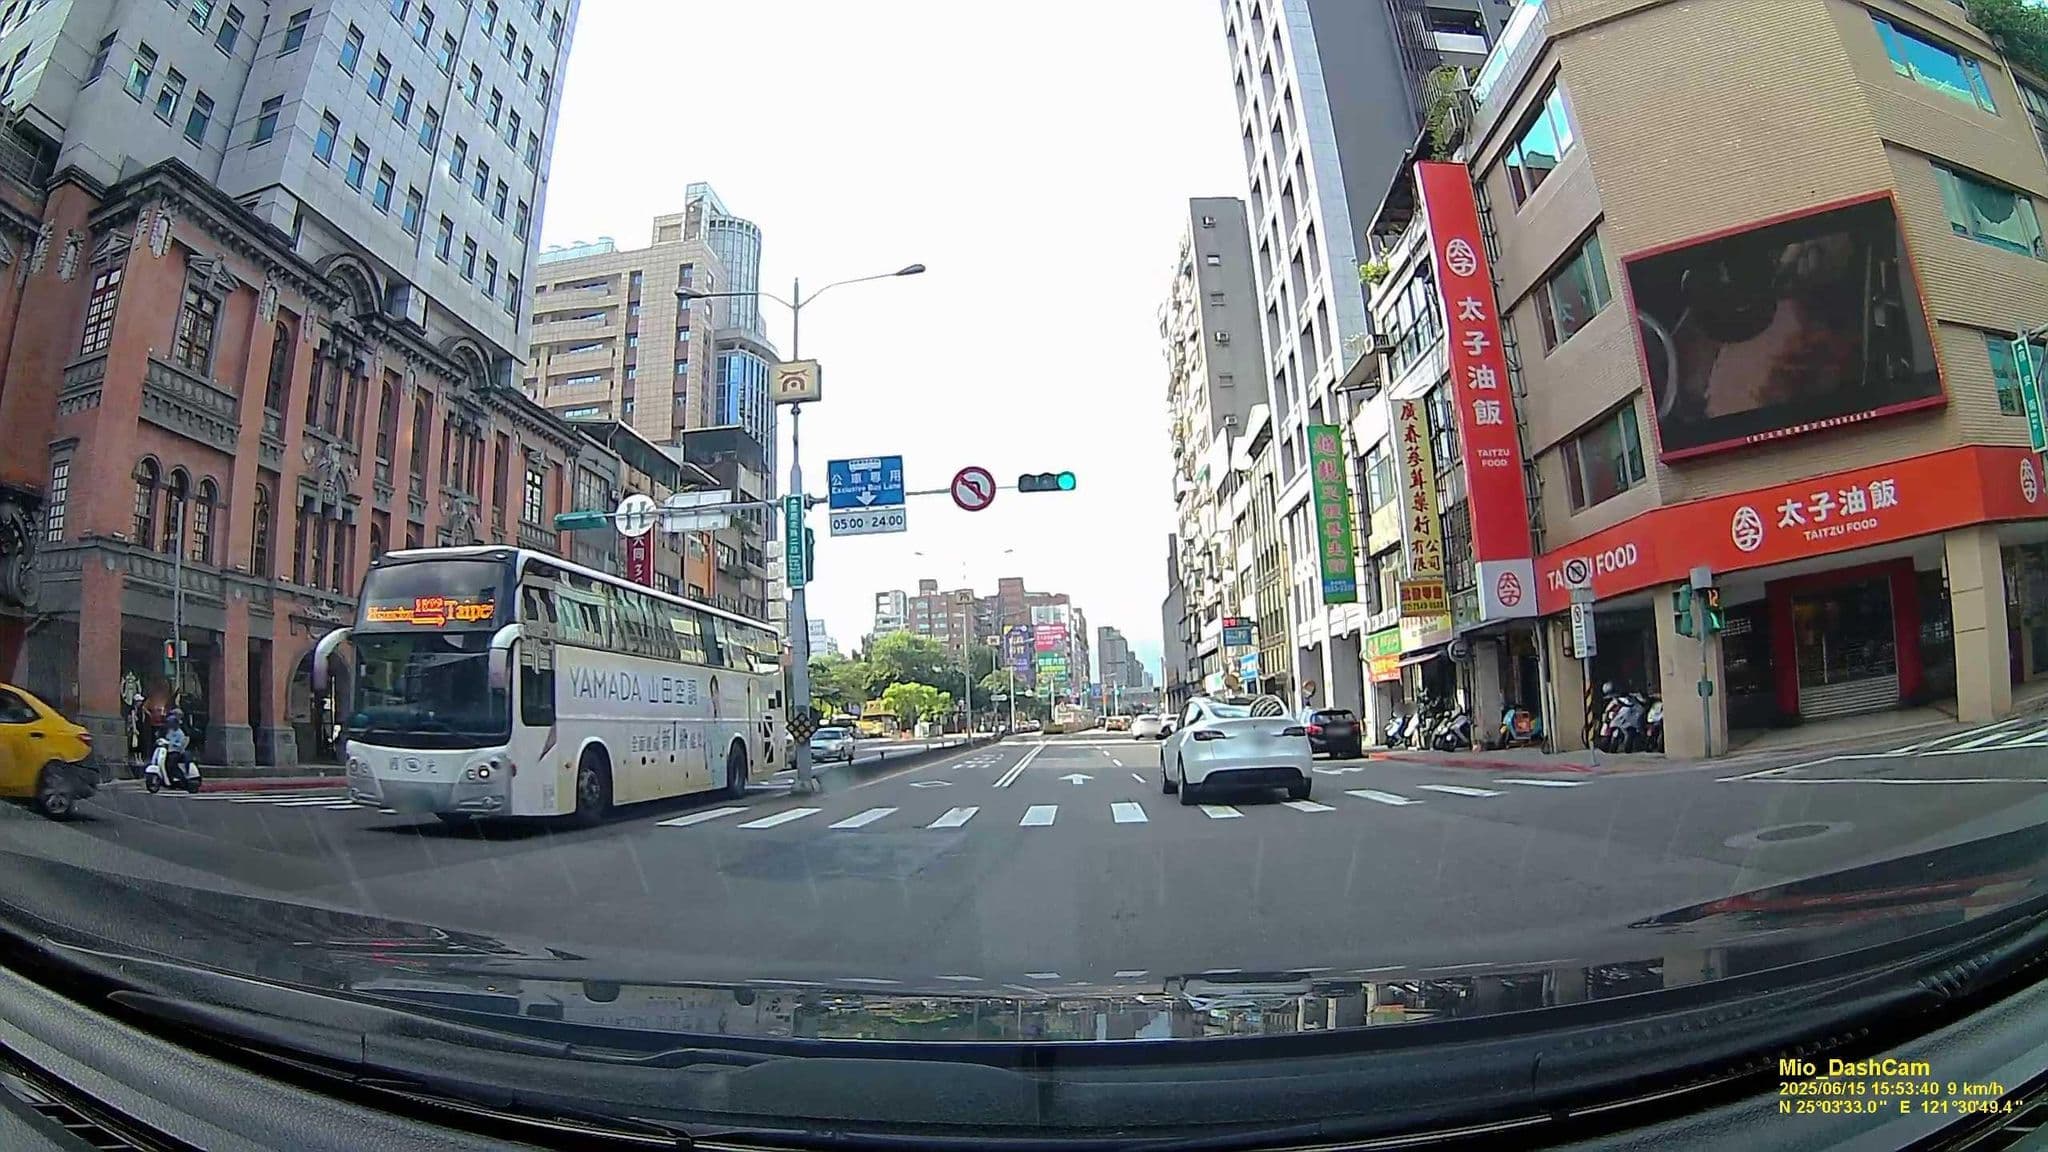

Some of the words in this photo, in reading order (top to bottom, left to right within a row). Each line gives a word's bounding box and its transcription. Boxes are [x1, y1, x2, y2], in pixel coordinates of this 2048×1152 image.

[1457, 296, 1503, 425] 太子油飯
[1478, 448, 1510, 458] TAITZU
[1481, 459, 1508, 468] FOOD
[831, 469, 901, 486] 公車專用
[1776, 478, 1898, 528] 太子油飯
[1803, 525, 1845, 541] TAITZU
[1846, 518, 1878, 532] FOOD
[1596, 543, 1637, 576] FOOD
[1707, 589, 1719, 607] 12
[569, 665, 642, 701] YAMADA
[648, 674, 697, 706] 山田空調
